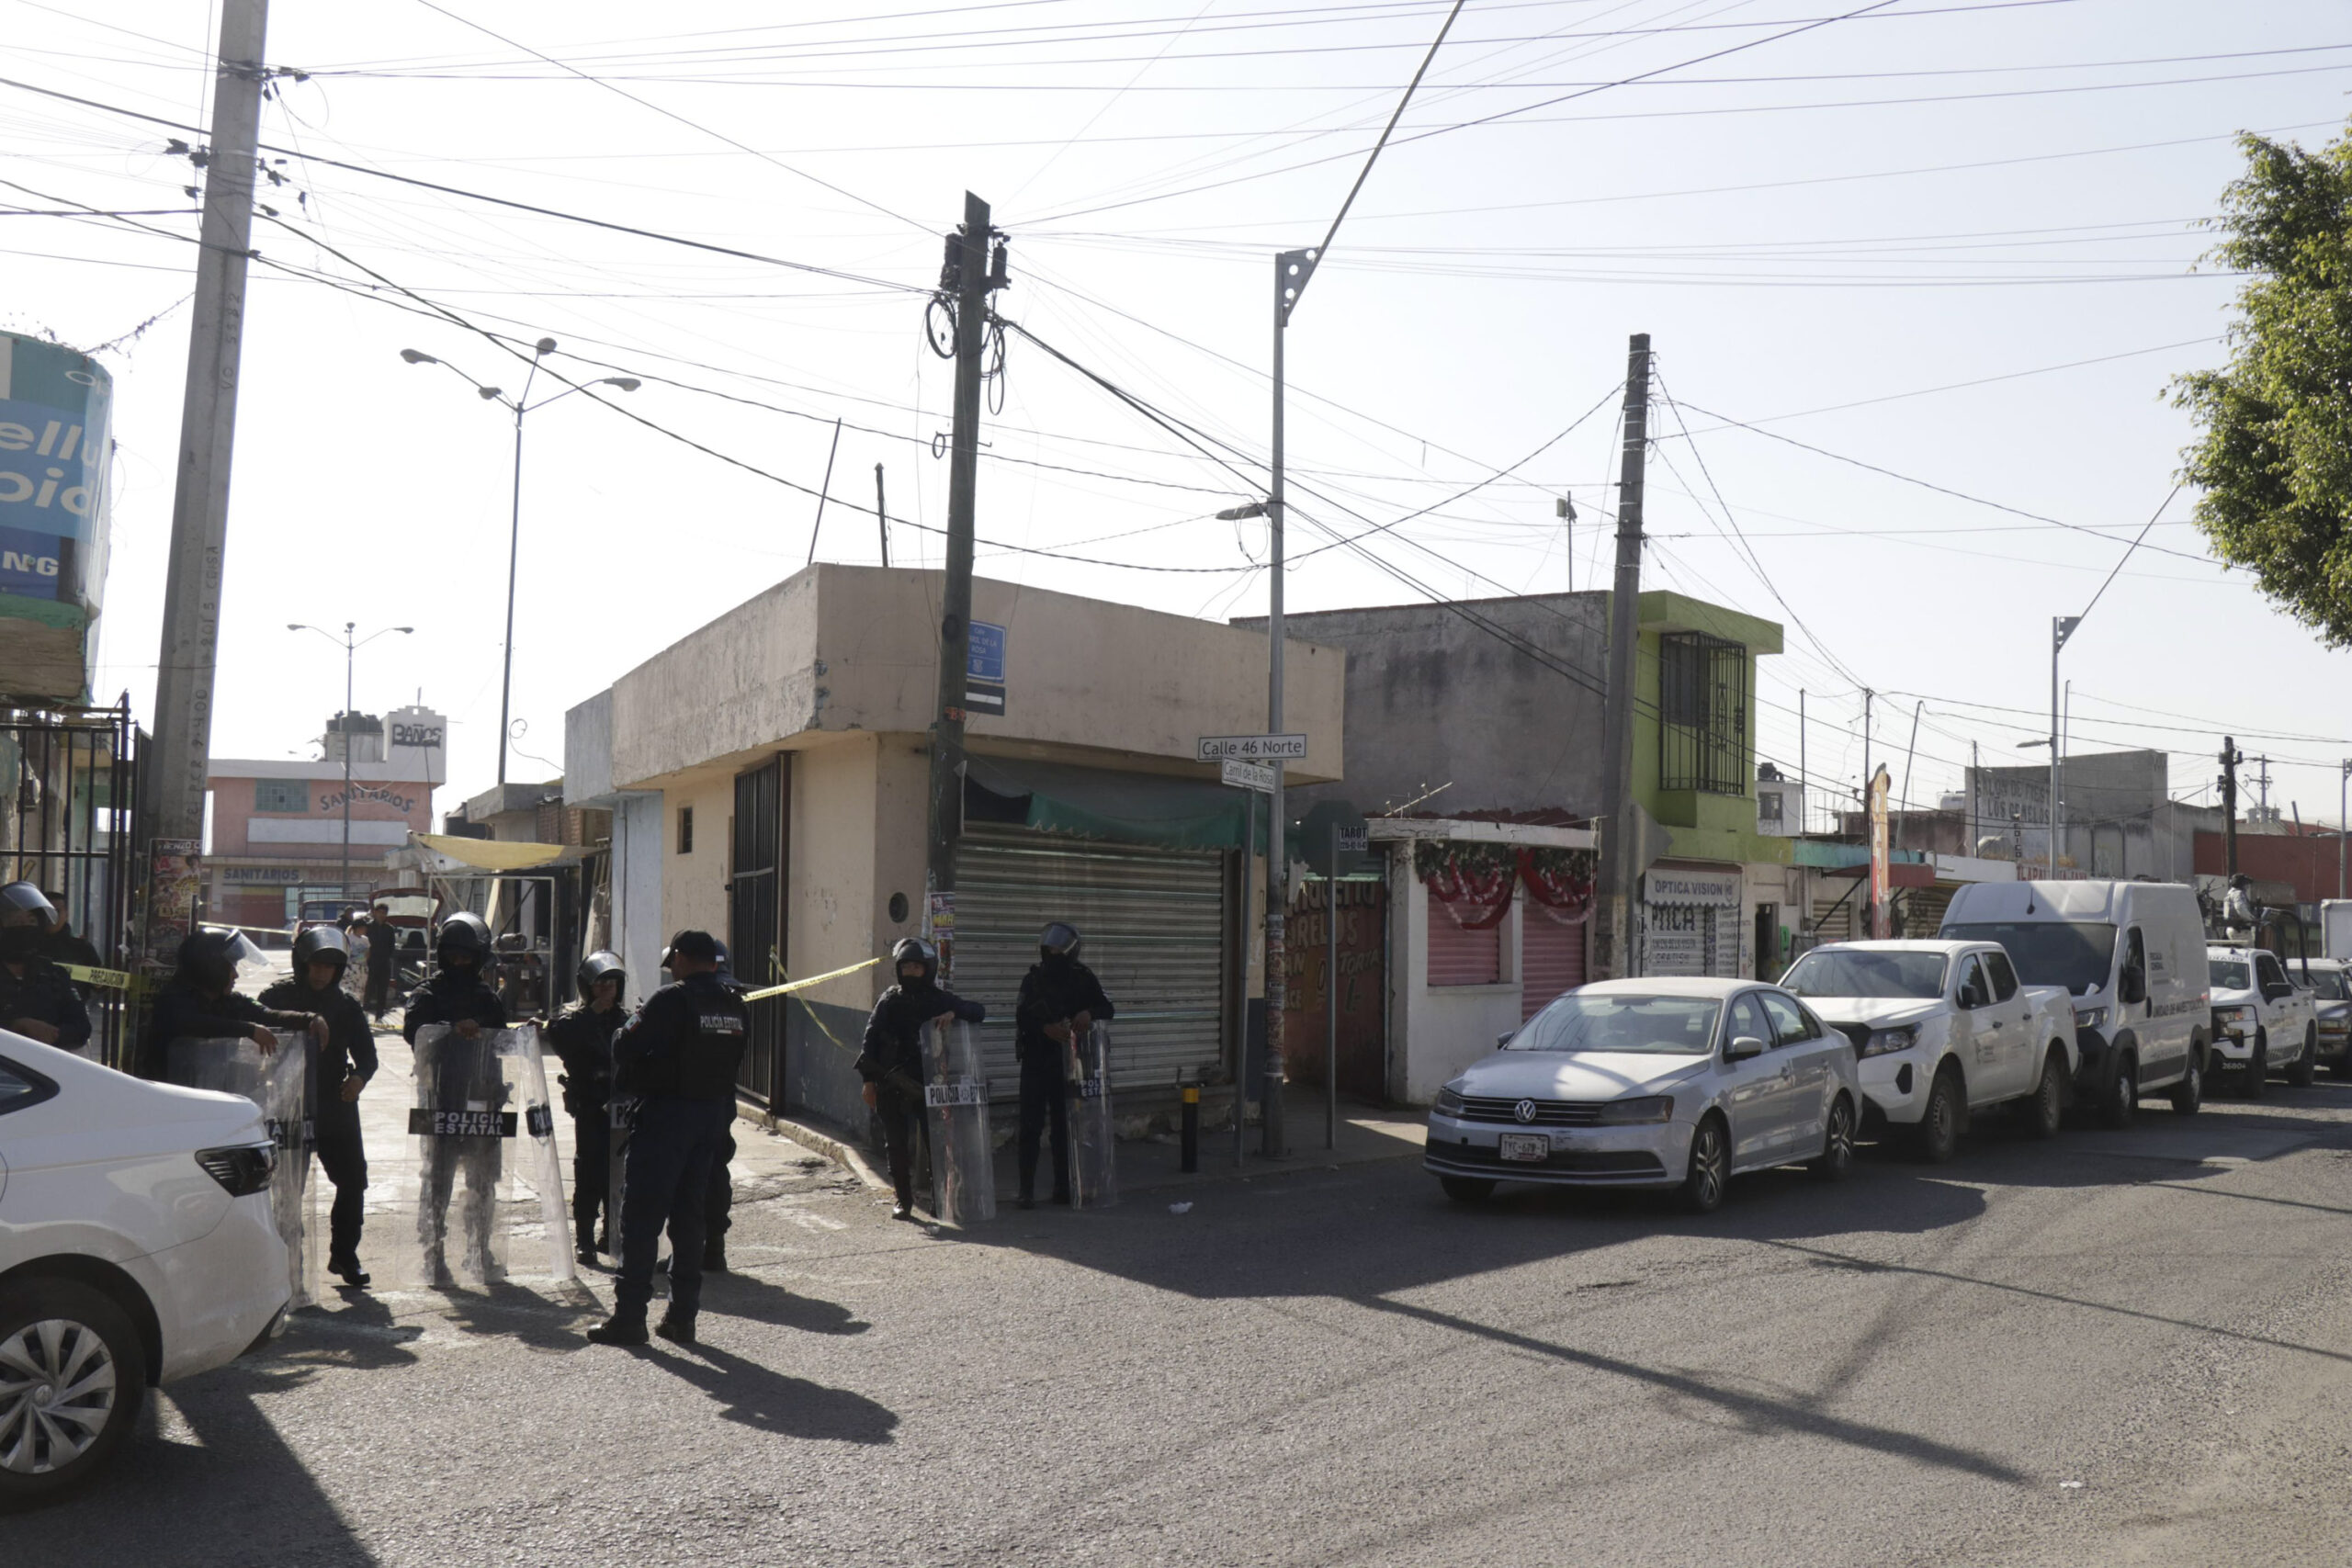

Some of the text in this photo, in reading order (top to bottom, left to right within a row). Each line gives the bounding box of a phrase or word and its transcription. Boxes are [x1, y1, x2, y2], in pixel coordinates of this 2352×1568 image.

[392, 724, 443, 745] BAÑOS
[1202, 740, 1302, 755] Calle 46 Norte
[1225, 761, 1273, 785] Carril de la Rosa
[320, 786, 416, 816] SANITARIOS
[1987, 797, 2007, 818] LOS
[1340, 828, 1367, 839] TAROT
[223, 868, 300, 880] SANITARIOS
[1655, 880, 1690, 895] OPTICA
[1692, 883, 1723, 896] VISION
[1652, 906, 1696, 931] PTICA
[700, 1014, 724, 1028] POLICÍA
[435, 1122, 503, 1136] ESTATAL
